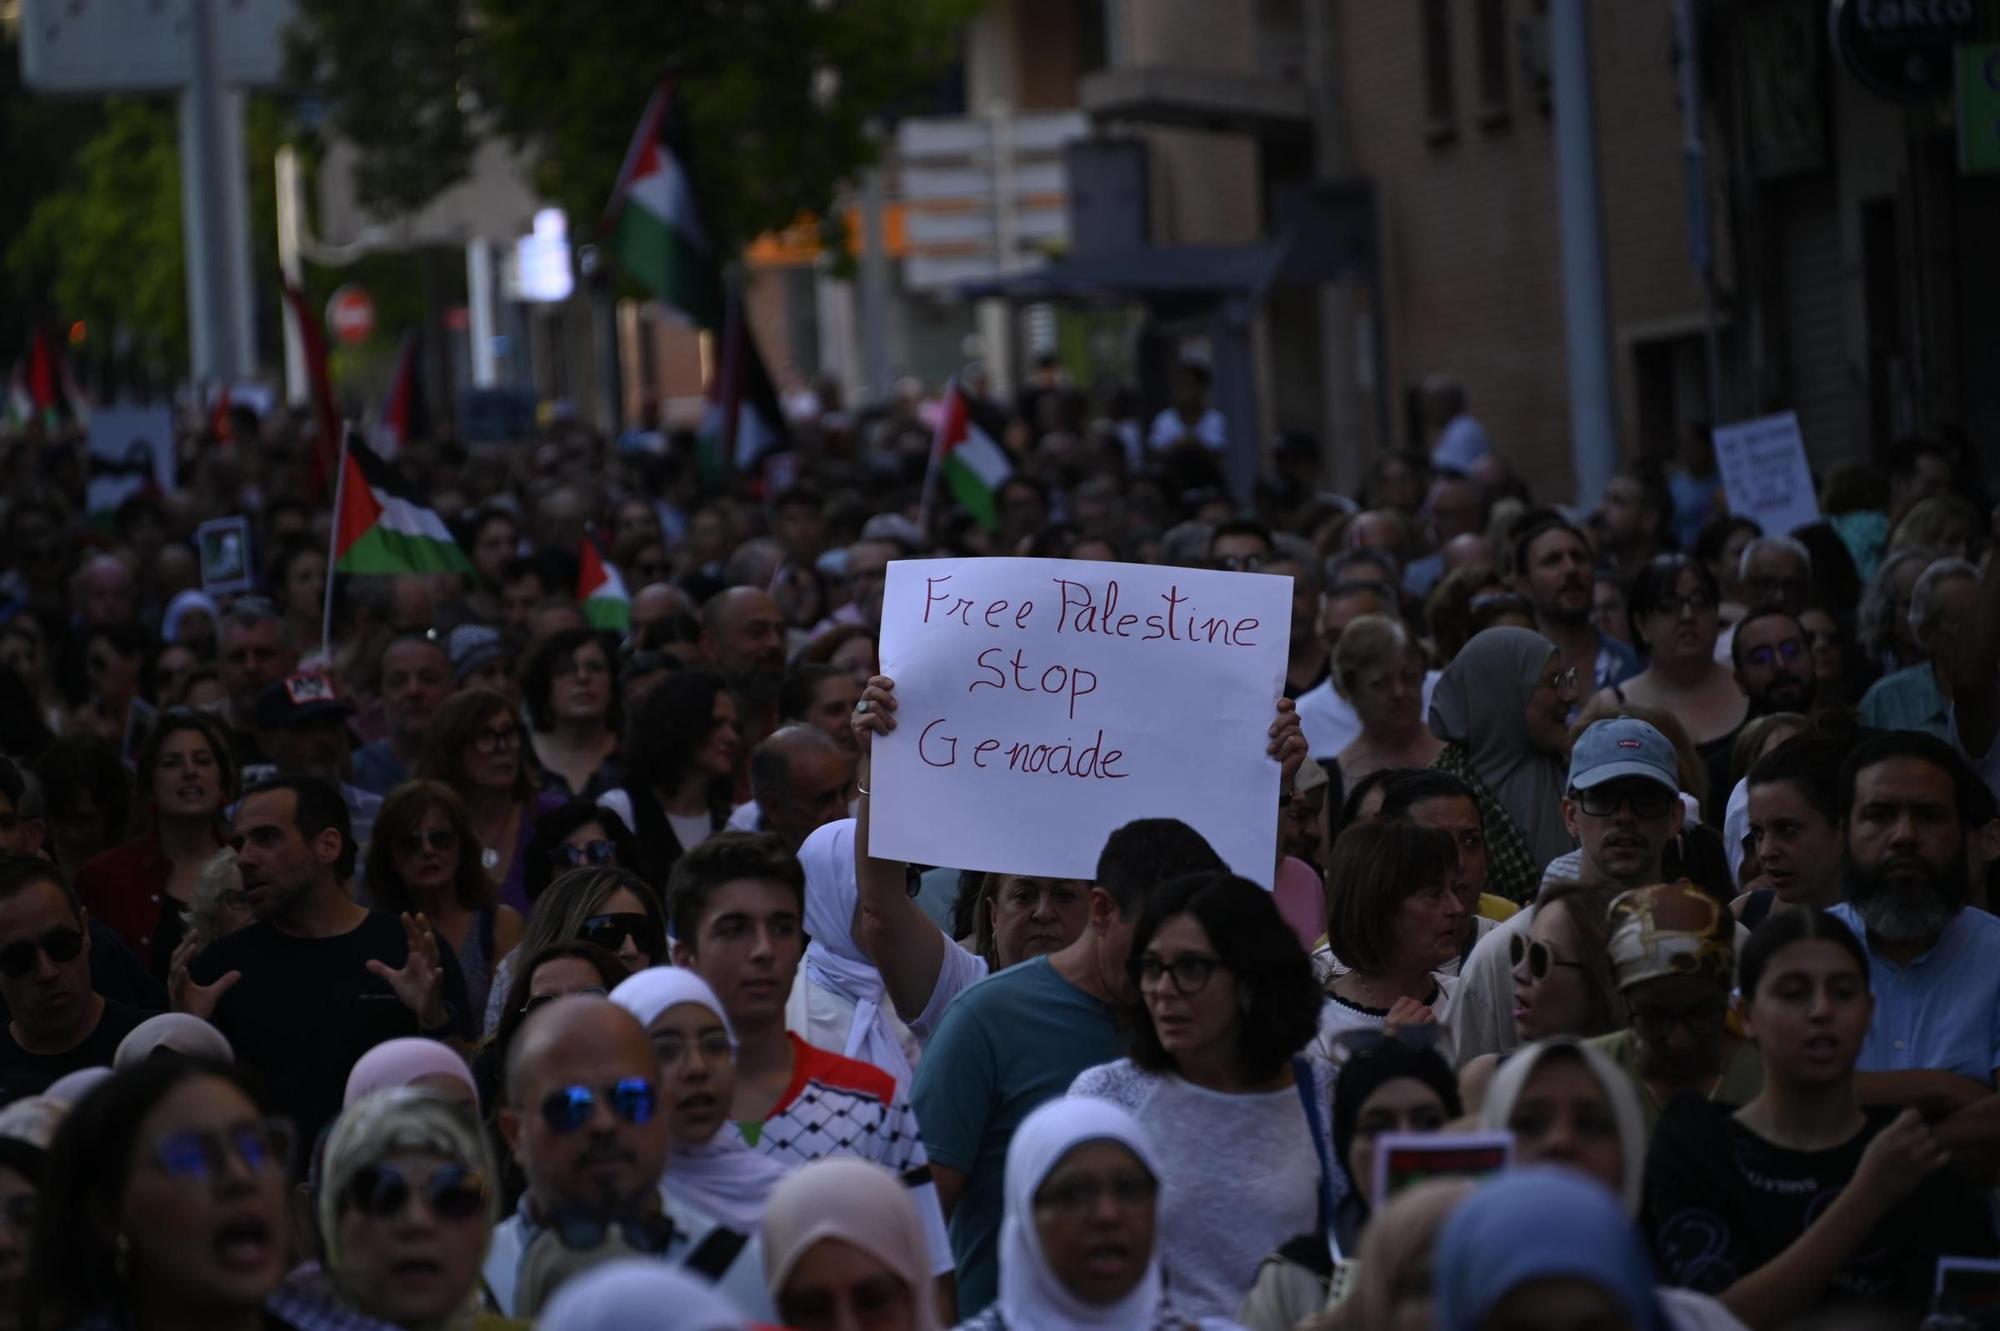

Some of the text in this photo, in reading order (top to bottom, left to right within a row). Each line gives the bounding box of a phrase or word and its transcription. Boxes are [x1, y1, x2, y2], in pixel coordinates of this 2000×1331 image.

[923, 575, 1260, 647] Free Palestine
[969, 648, 1097, 720] Stop
[918, 718, 1130, 780] Genocide
